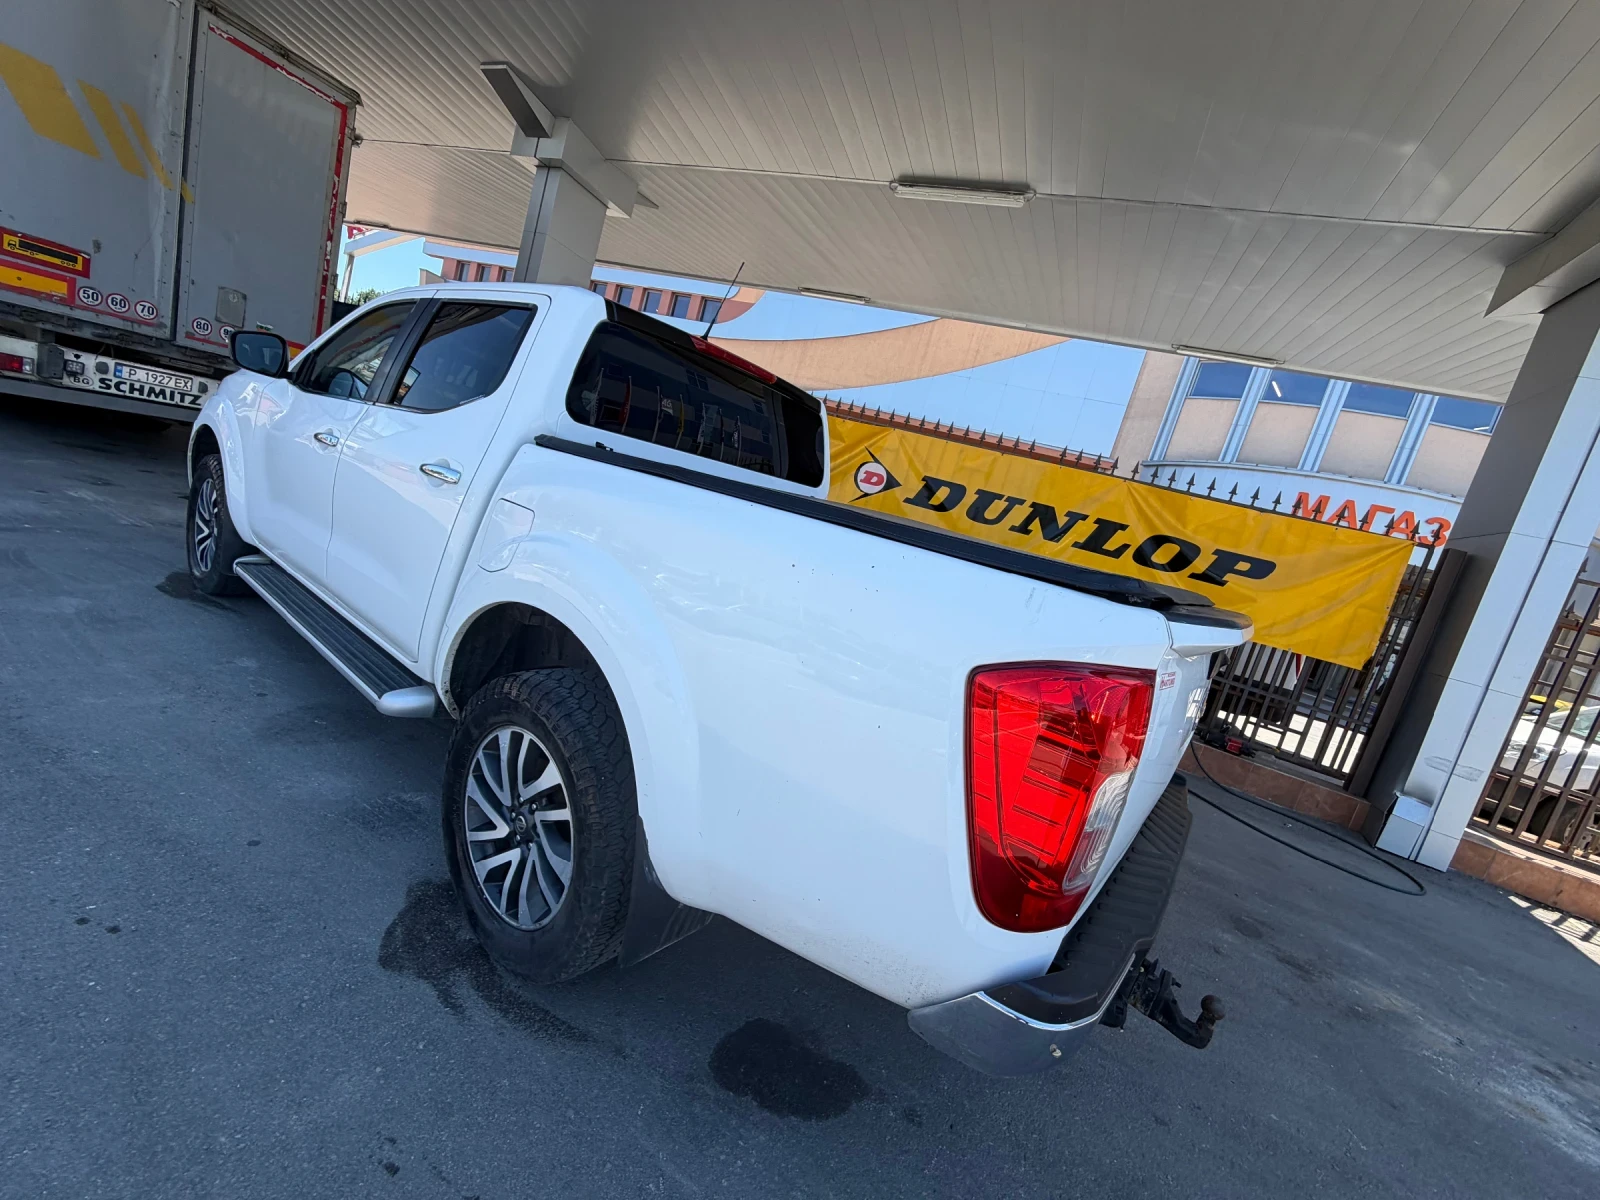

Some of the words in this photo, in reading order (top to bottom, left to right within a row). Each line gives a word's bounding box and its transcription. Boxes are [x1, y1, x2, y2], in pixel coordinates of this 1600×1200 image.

[82, 289, 99, 302] 50
[110, 296, 127, 309] 60
[139, 303, 155, 316] 70
[195, 320, 209, 331] 80
[73, 376, 90, 385] BG
[145, 372, 172, 386] 1927
[98, 377, 202, 406] SCHMITZ
[1289, 491, 1453, 548] МАГАЗ
[859, 470, 885, 487] D
[902, 475, 1277, 587] DUNLOP
